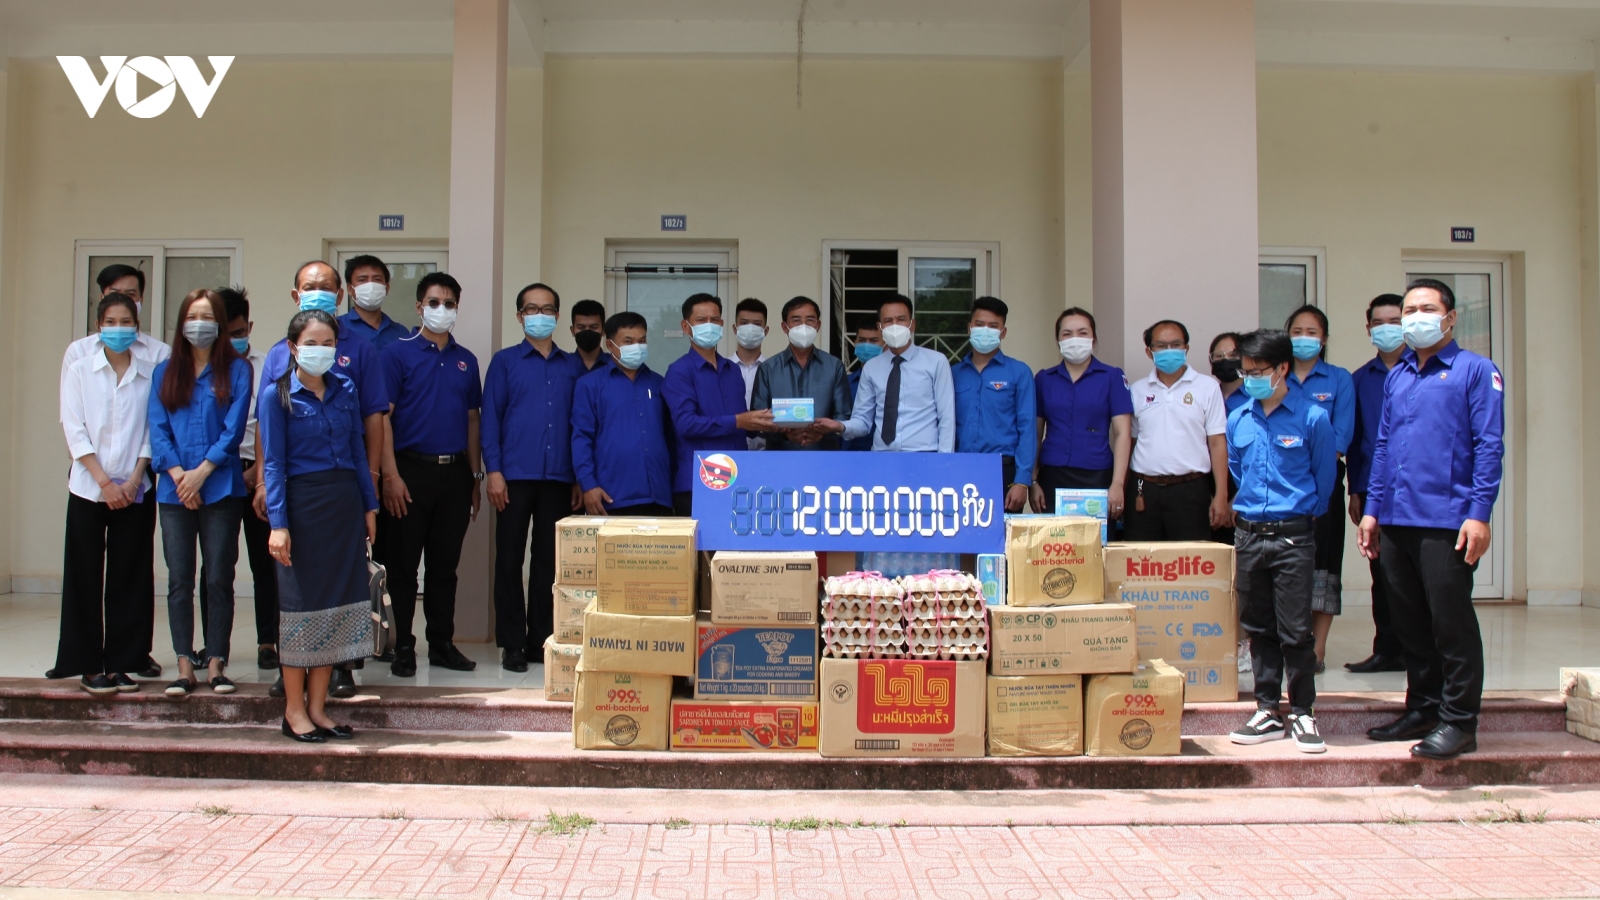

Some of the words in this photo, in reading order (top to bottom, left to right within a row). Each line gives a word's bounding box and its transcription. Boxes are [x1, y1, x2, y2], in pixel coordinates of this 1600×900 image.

[382, 218, 401, 228] 101/2
[664, 218, 683, 228] 102/2
[1454, 230, 1472, 240] 103/2
[1032, 557, 1085, 566] anti-bacterial
[718, 565, 761, 574] OVALTINE
[763, 565, 784, 574] 3IN1
[1126, 555, 1215, 582] kinglife
[1163, 590, 1210, 601] TRANG
[1026, 614, 1041, 624] CP
[1081, 616, 1104, 624] TRANG
[1165, 623, 1184, 636] CE
[1192, 623, 1223, 636] FDA
[756, 632, 794, 642] TEAPOT
[1024, 634, 1031, 642] X
[1032, 634, 1042, 642] 50
[589, 636, 632, 650] TAIWAN
[636, 640, 648, 651] IN
[653, 640, 685, 652] MADE
[699, 683, 707, 692] Net
[707, 683, 720, 694] Weight
[737, 684, 753, 694] pouches
[595, 704, 650, 713] anti-bacterial
[1111, 708, 1165, 716] anti-bacterial
[803, 713, 813, 721] 10
[733, 719, 750, 727] SAUCE
